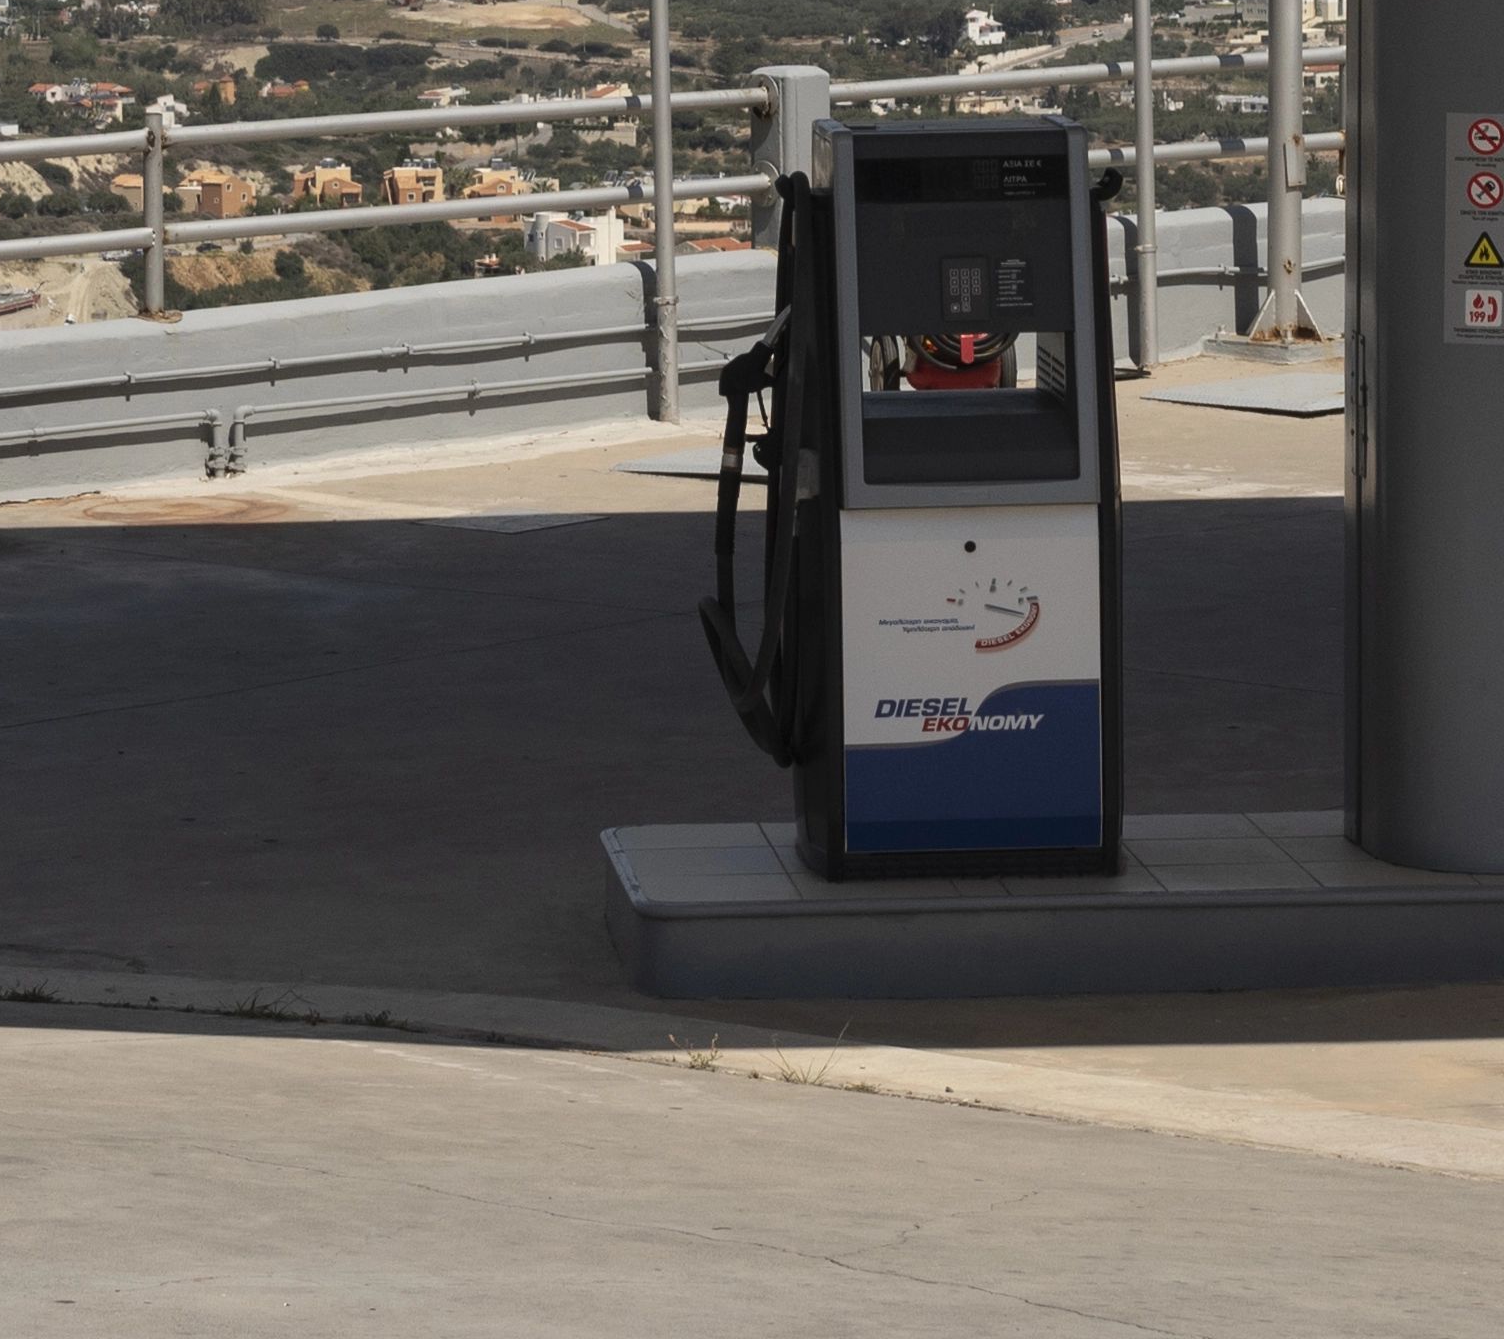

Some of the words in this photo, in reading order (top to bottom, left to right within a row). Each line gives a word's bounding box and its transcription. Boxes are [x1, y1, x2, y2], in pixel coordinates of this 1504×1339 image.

[1003, 175, 1028, 183] ΛΙΤΡΑ
[1469, 311, 1486, 322] 199
[980, 633, 1014, 647] DIESEL
[874, 697, 973, 718] DIESEL
[922, 714, 1045, 732] EKONOMY
